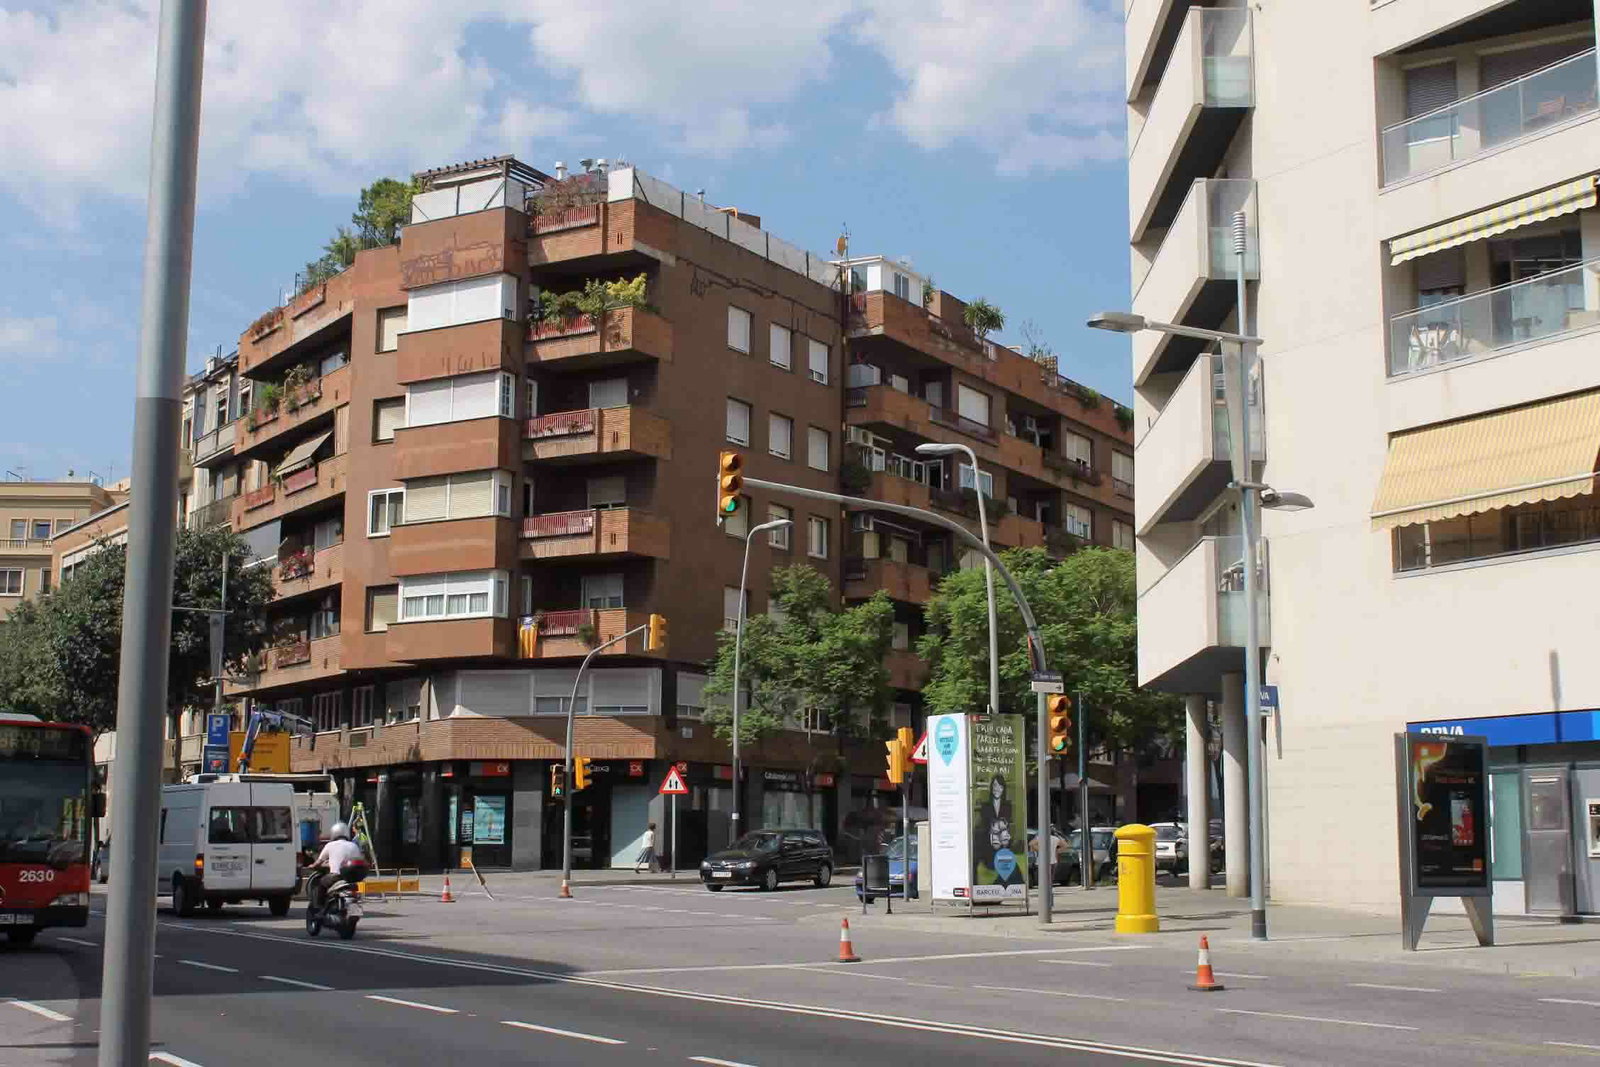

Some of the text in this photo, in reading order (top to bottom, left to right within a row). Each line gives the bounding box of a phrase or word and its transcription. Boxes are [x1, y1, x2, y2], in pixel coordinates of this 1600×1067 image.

[212, 717, 223, 732] P
[995, 726, 1013, 734] CADA
[1002, 735, 1012, 744] DE
[497, 765, 509, 773] CX
[630, 764, 642, 772] CX
[677, 762, 687, 772] CX
[19, 870, 54, 882] 2630
